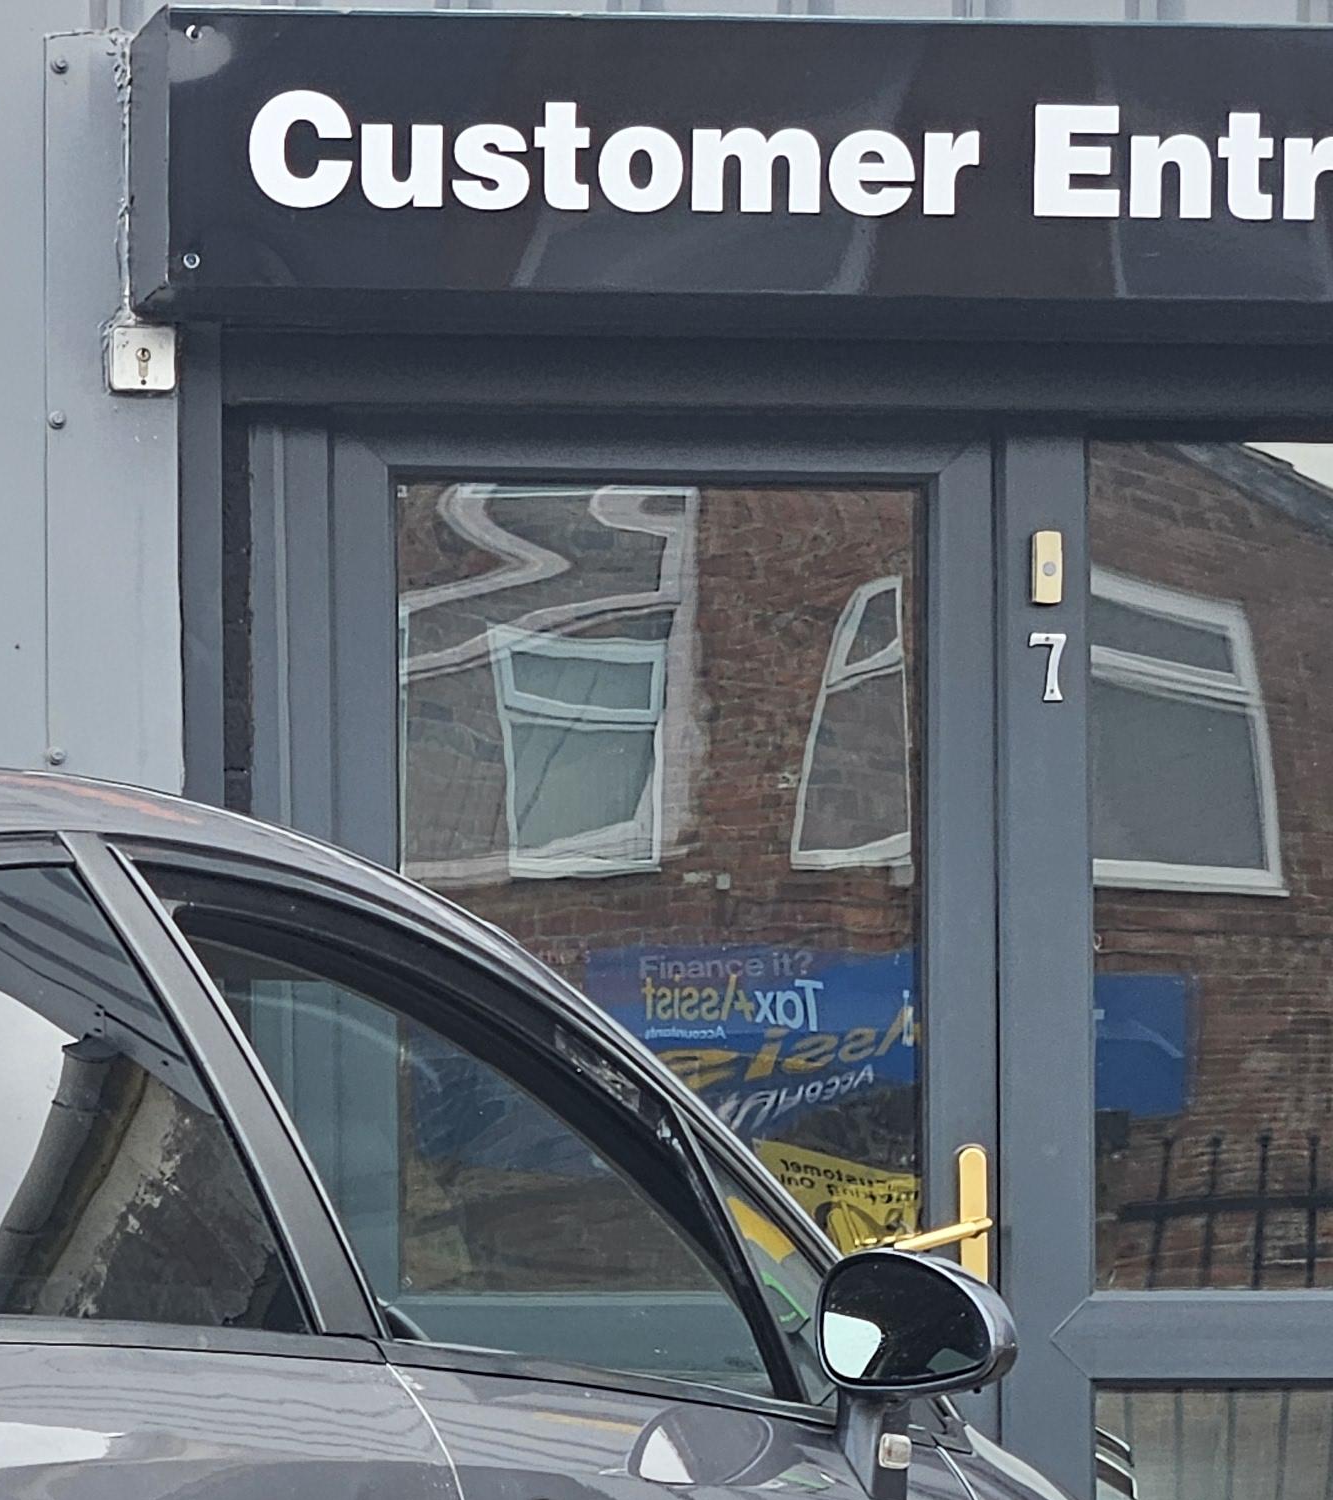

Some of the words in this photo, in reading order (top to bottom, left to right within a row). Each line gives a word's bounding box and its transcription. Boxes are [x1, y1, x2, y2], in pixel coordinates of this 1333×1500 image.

[247, 88, 981, 217] Customer
[1029, 632, 1066, 701] 7
[639, 954, 764, 980] Finance
[772, 951, 813, 977] it?
